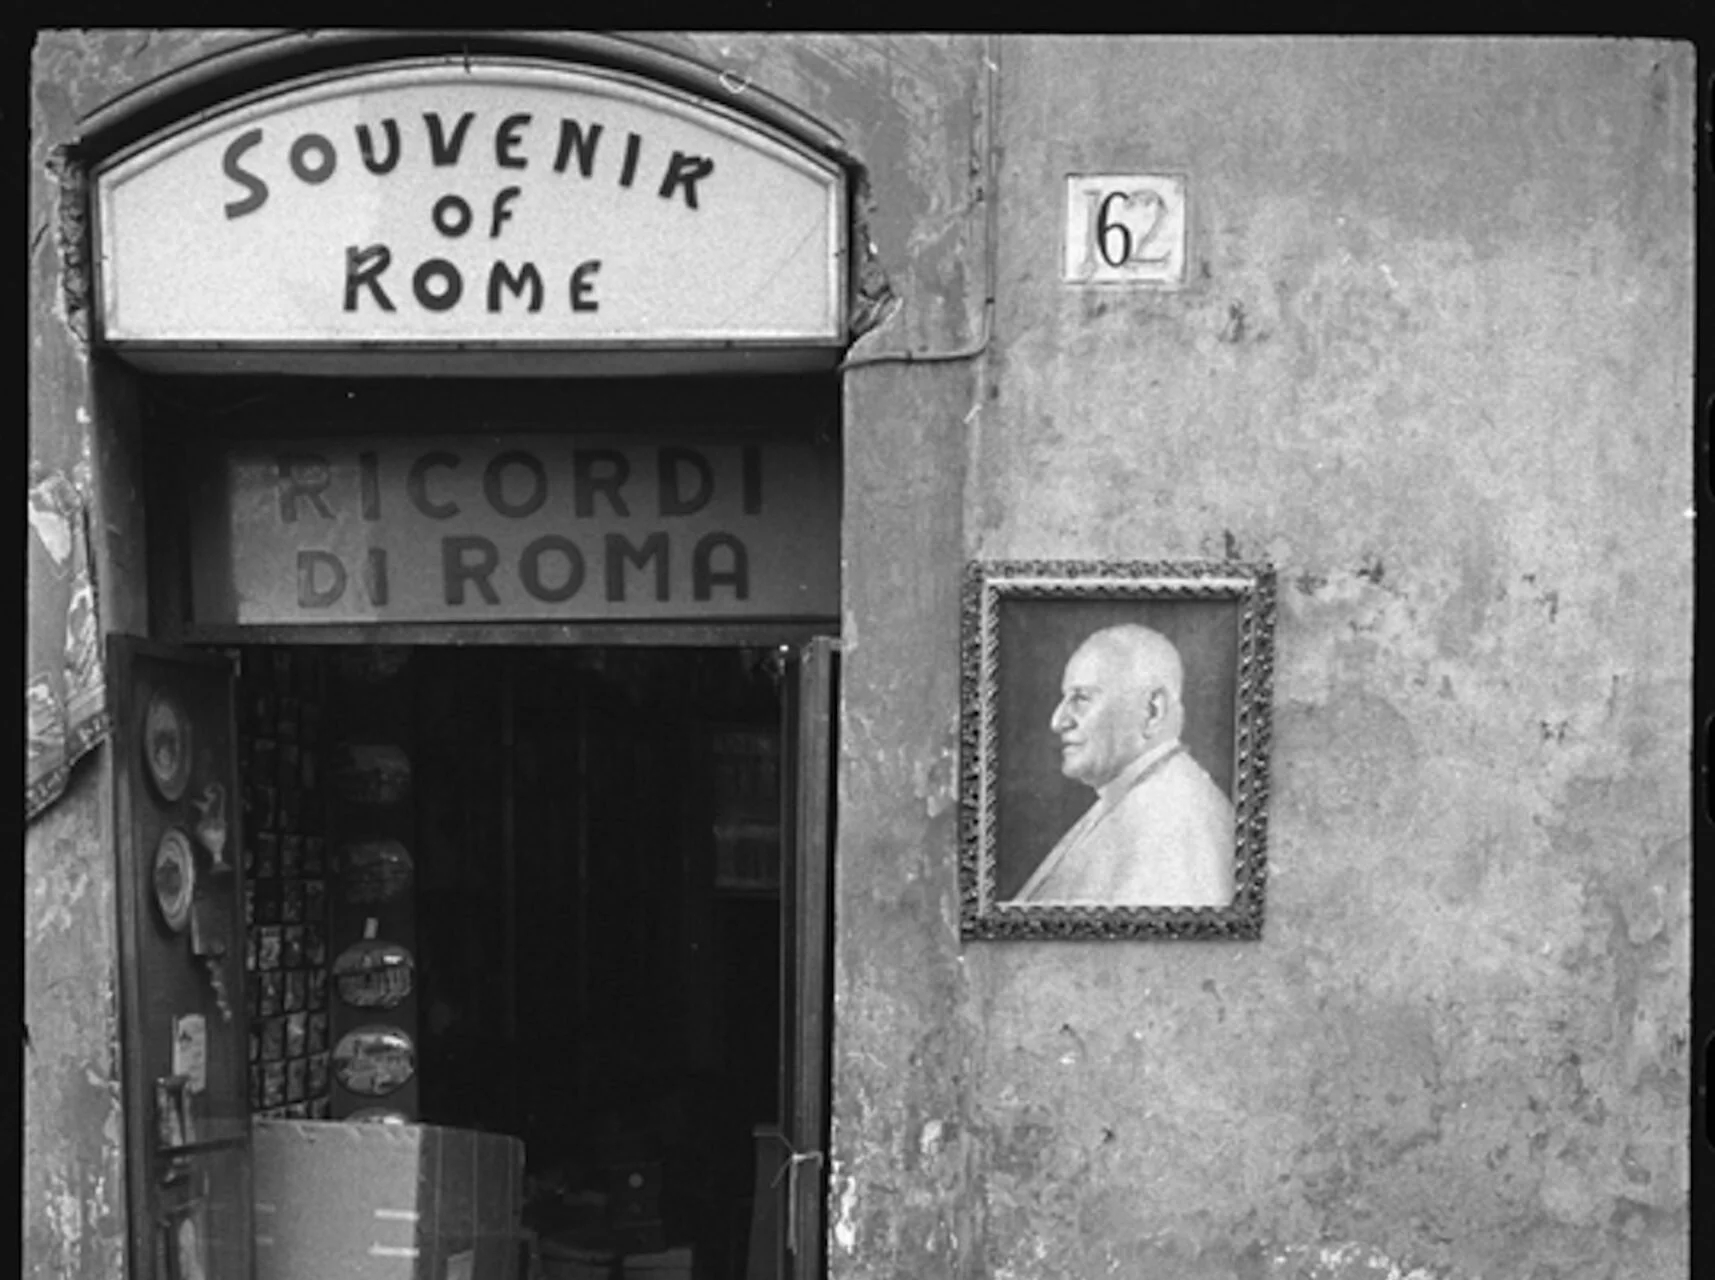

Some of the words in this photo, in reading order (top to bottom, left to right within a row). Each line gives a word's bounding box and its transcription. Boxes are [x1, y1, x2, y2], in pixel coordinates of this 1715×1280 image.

[222, 112, 715, 219] SOUVENIR
[431, 185, 521, 238] OF
[343, 244, 604, 313] ROME
[275, 445, 763, 523] RICORDI
[296, 547, 388, 608] DI
[441, 531, 751, 605] ROMA
